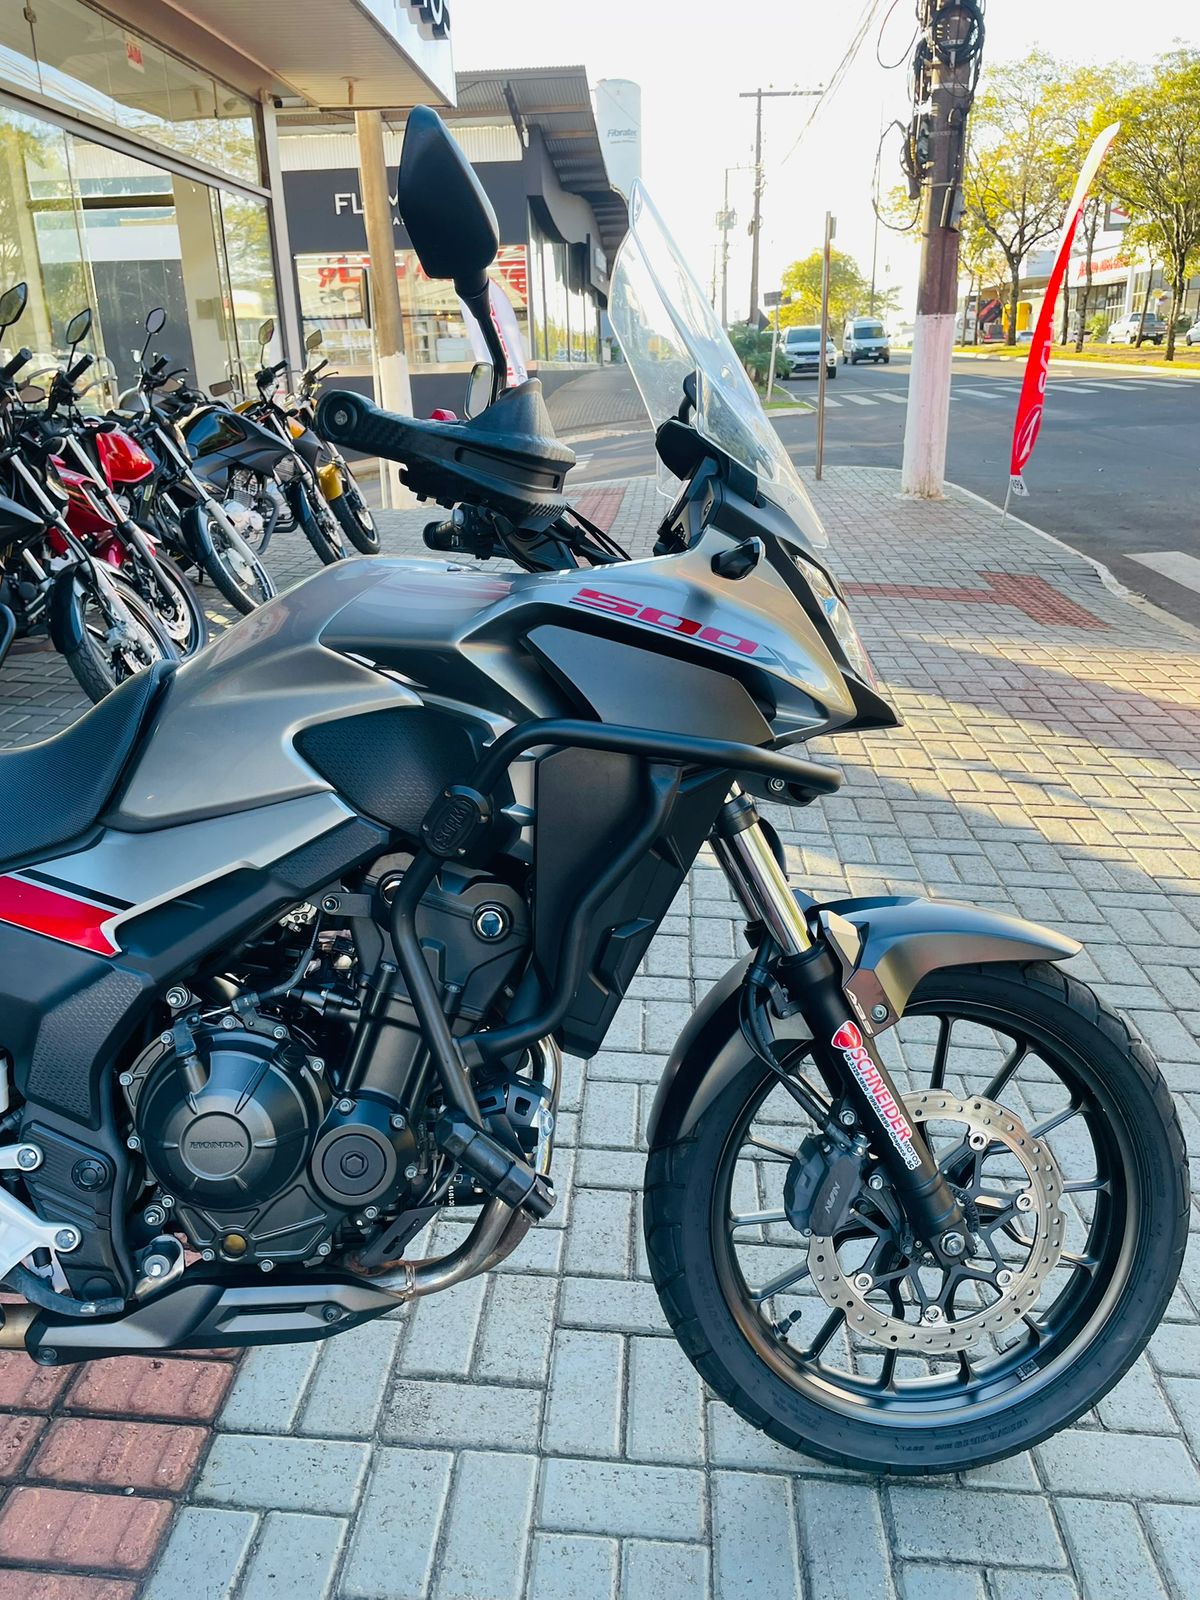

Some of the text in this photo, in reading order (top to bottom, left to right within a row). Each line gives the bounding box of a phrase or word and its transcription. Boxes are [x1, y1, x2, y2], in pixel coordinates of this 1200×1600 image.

[845, 988, 874, 1034] ABS
[850, 1047, 921, 1167] SCHNEIDER MOTOS
[190, 1141, 244, 1149] HONDA
[905, 1159, 915, 1169] SC
